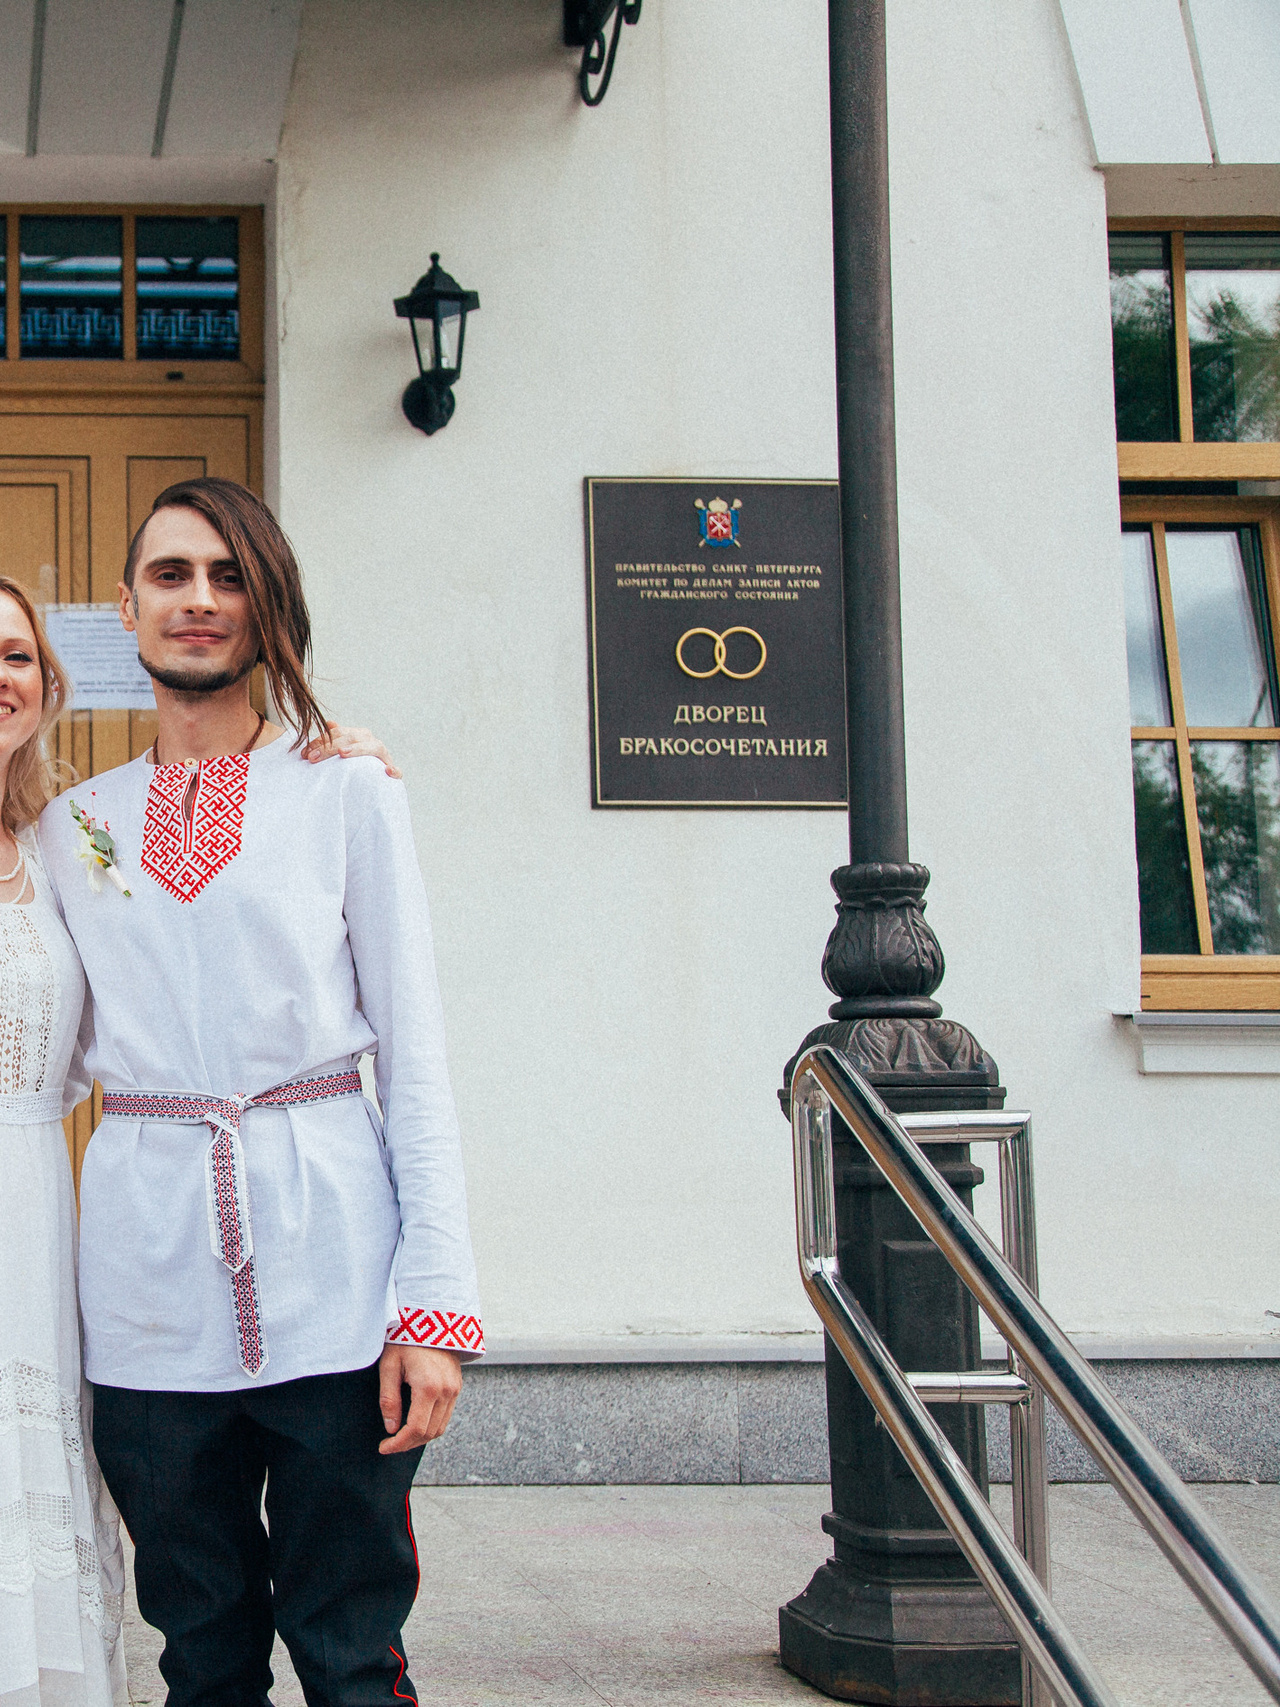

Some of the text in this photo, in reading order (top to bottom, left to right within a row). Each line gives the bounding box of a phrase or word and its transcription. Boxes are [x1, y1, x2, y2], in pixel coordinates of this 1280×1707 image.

[615, 563, 706, 574] ПРАВИТЕЛЬСТВО
[617, 578, 820, 589] КОМИТЕТ ПО ДЕЛАМ ЗАПИСИ АКТОВ
[640, 590, 799, 601] ГРАЖДАНСКОГО СОСТОЯНИЯ
[673, 705, 768, 727] ДВОРЕЦ
[619, 737, 829, 757] БРАКОСОЧЕТАНИЯ
